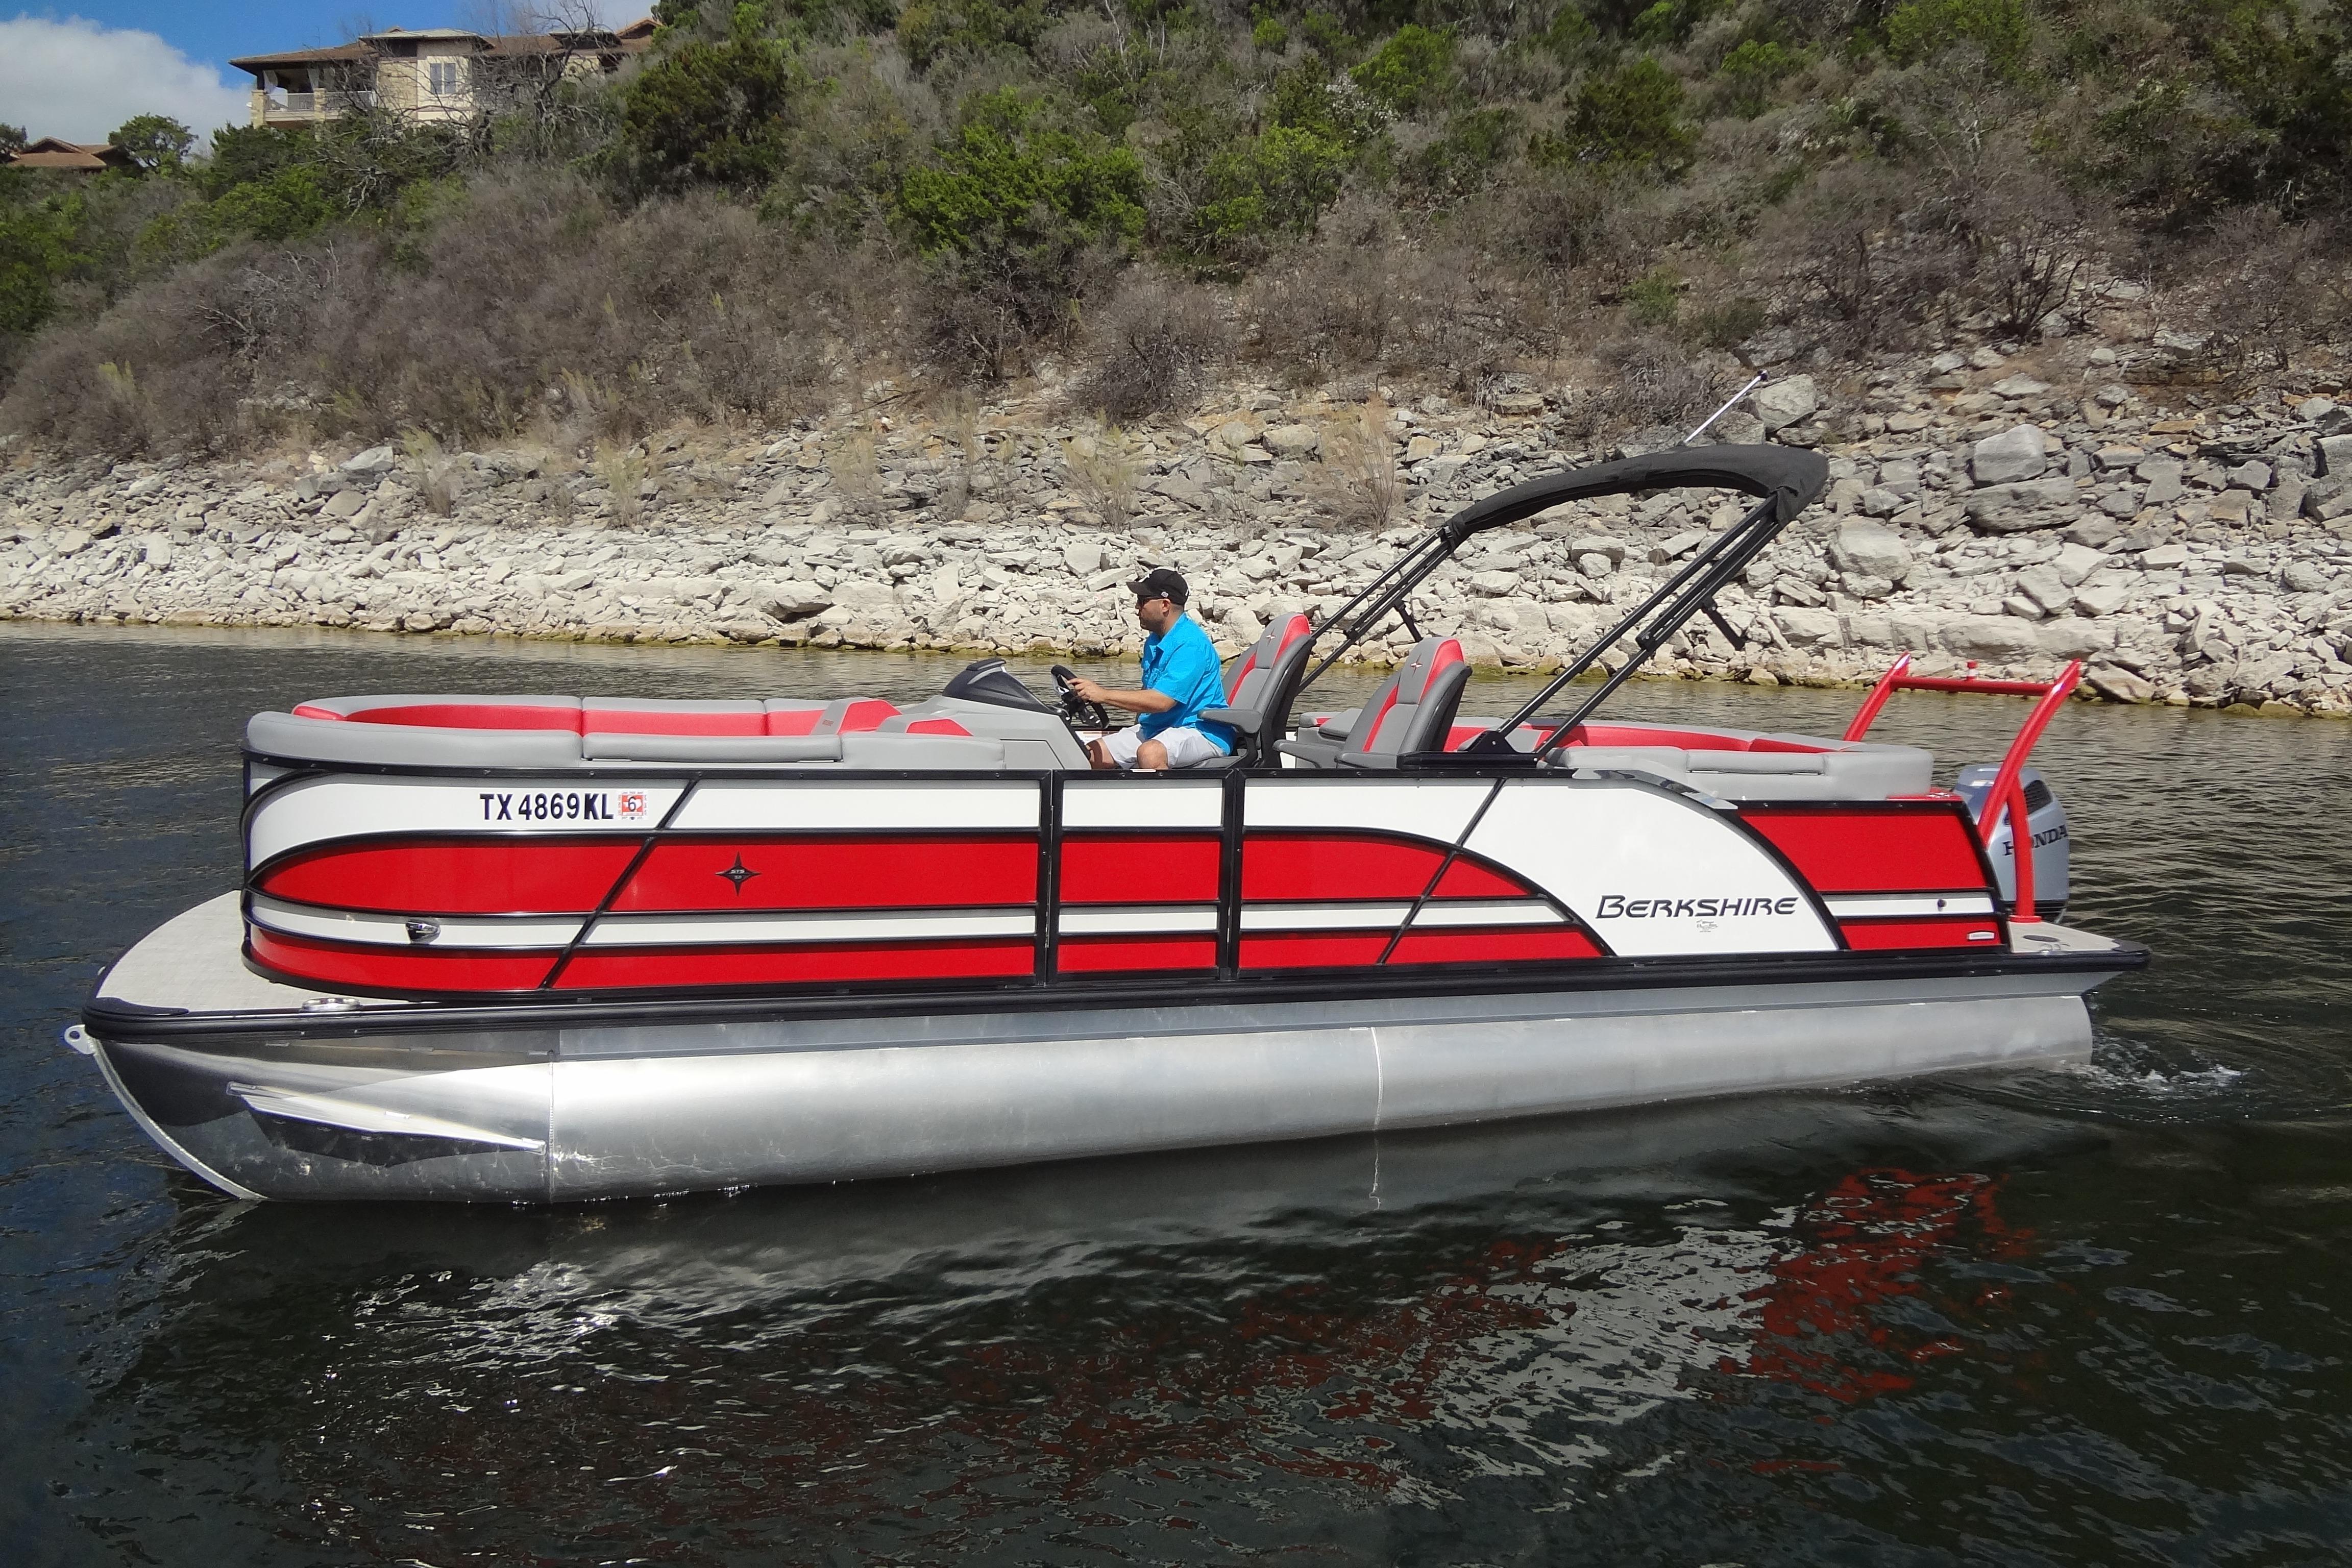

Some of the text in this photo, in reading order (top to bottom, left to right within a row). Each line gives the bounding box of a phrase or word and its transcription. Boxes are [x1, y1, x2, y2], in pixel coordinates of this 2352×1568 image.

[480, 793, 512, 820] TX
[628, 796, 636, 812] 6
[2002, 824, 2068, 856] HNDA
[1596, 895, 1799, 919] BERKSHIRE
